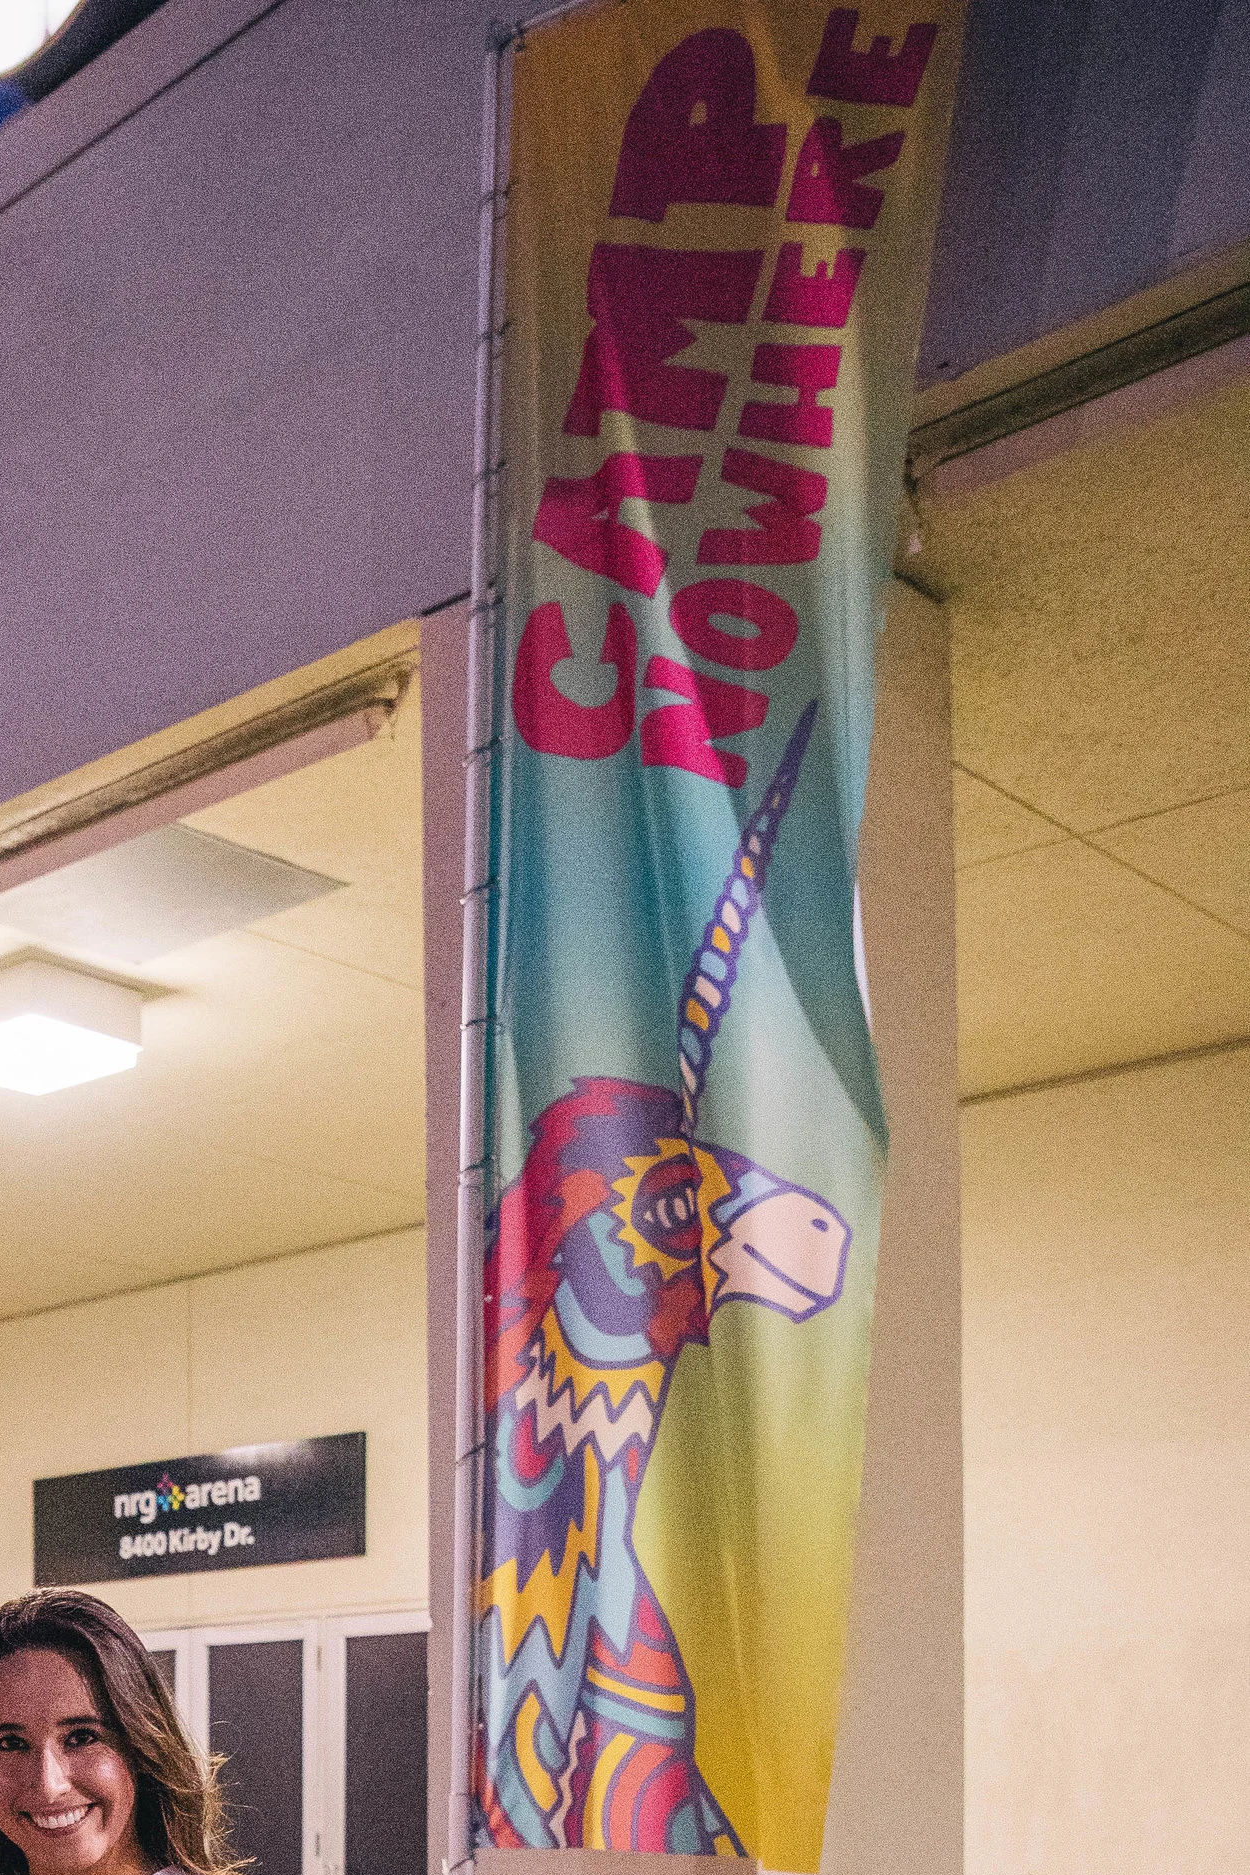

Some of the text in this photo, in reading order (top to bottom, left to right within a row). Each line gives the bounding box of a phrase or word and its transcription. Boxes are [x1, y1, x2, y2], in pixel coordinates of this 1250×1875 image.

[511, 27, 788, 760] CAMP
[639, 8, 939, 789] NOWHERE
[113, 1476, 262, 1524] nrg arena
[119, 1521, 256, 1560] 8400 Kirby Dr.
